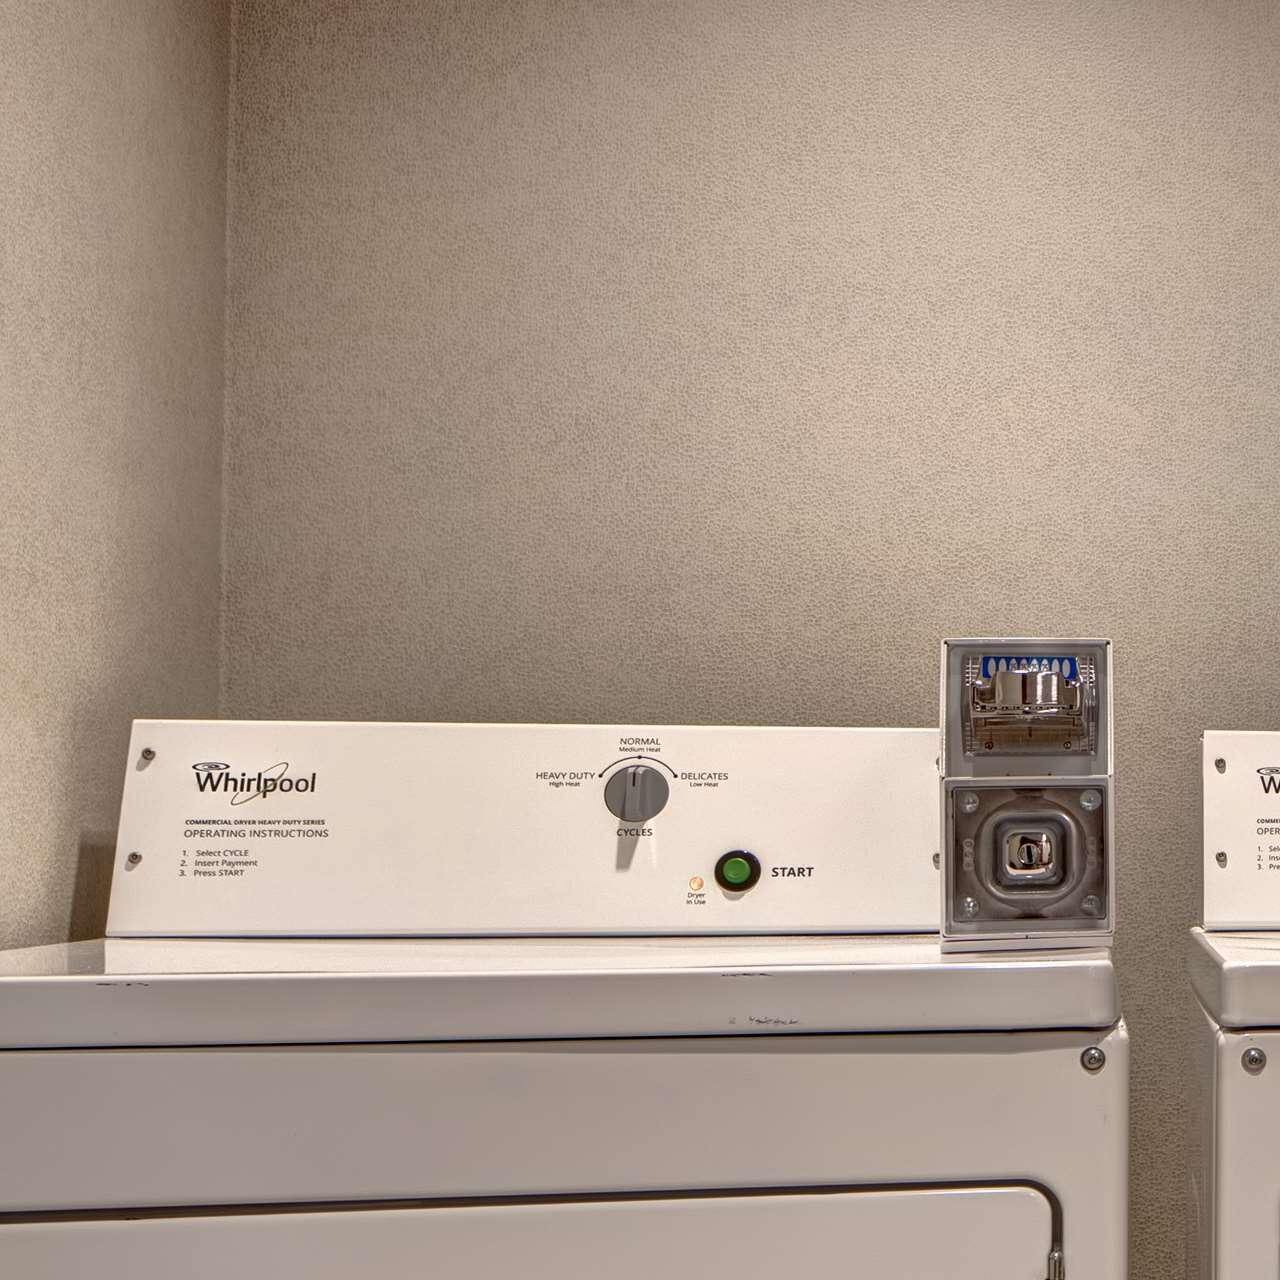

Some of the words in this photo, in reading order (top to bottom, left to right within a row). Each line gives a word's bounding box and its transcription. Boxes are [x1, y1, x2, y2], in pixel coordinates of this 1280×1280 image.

[620, 738, 661, 746] NORMAL
[535, 772, 567, 780] HEAVY
[569, 772, 596, 780] DUTY
[680, 772, 729, 781] DELICATES
[195, 771, 317, 799] Whirlpool
[183, 829, 246, 838] OPERATING
[249, 829, 329, 838] INSTRUCTIONS
[616, 828, 653, 837] CYCLES
[196, 849, 221, 857] Select
[180, 859, 188, 867] 2.
[194, 859, 219, 867] Insert
[221, 859, 258, 868] Payment
[1257, 863, 1264, 871] 3.
[178, 869, 187, 877] 3.
[193, 869, 217, 877] Press
[218, 869, 245, 877] START
[771, 867, 814, 878] START
